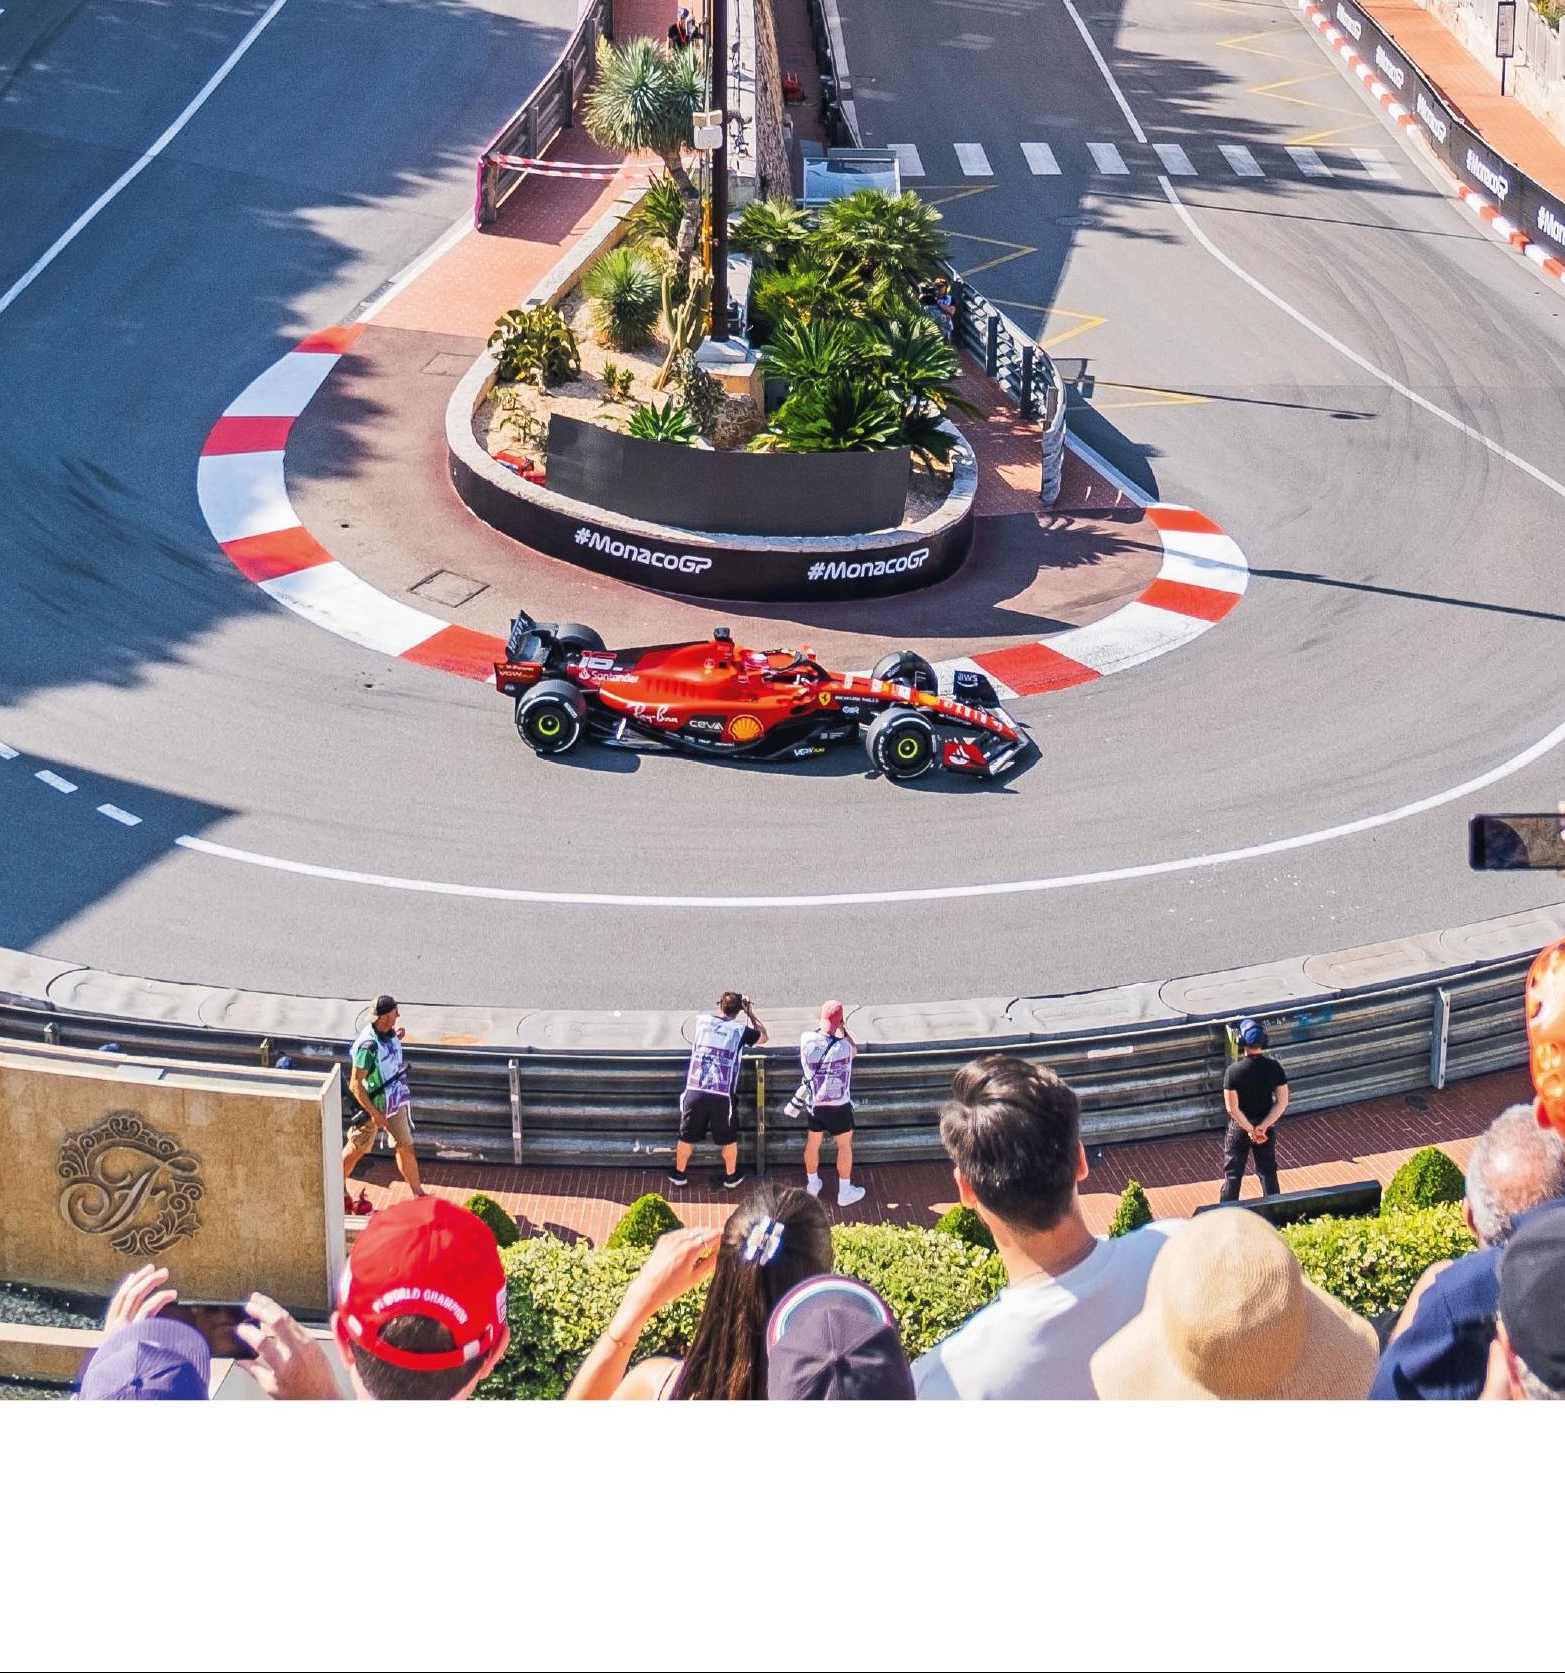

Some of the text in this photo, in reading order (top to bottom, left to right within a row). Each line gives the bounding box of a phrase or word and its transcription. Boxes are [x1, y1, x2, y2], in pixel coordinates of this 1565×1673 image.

[572, 526, 713, 575] #MonacoGP
[807, 546, 931, 583] #MonacoGP
[590, 669, 640, 684] Santander
